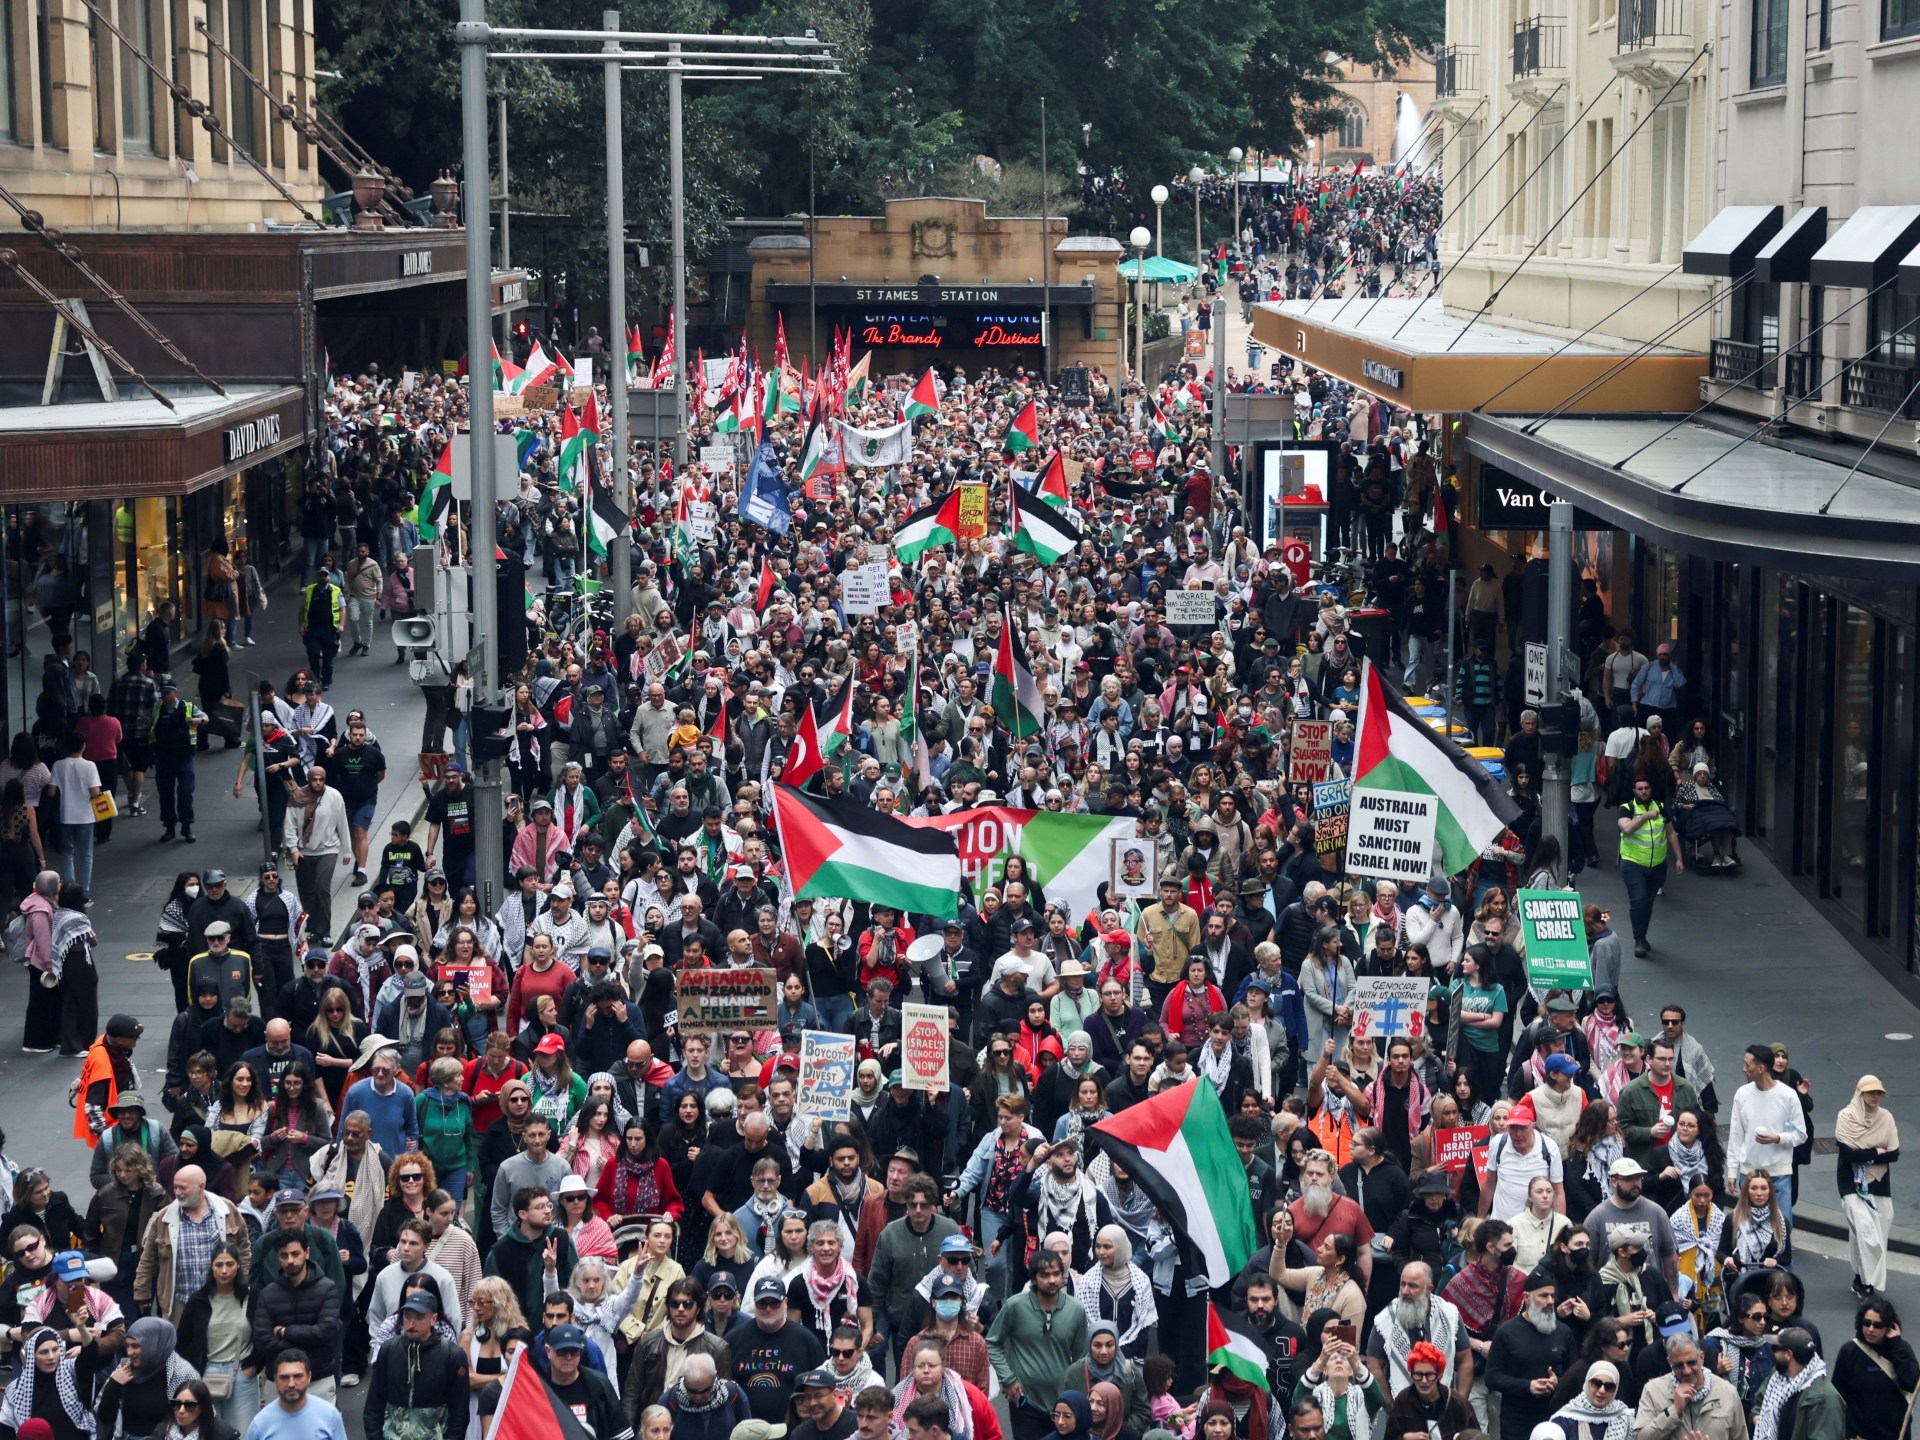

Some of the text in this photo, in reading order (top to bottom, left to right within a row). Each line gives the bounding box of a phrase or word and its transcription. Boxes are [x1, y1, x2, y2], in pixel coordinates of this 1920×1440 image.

[857, 291, 998, 300] ST JAMES STATION
[863, 325, 942, 348] The Brandy
[230, 414, 280, 460] DAVID JONES
[1496, 489, 1534, 506] Van
[1528, 650, 1543, 665] ONE
[1527, 667, 1545, 684] WAY
[1298, 724, 1328, 740] STOP
[1305, 740, 1320, 748] THE
[1292, 747, 1331, 762] SLAUGHTER
[1292, 763, 1328, 781] NOW
[1316, 803, 1348, 819] NO ON
[1360, 796, 1427, 816] AUSTRALIA
[1373, 817, 1410, 833] MUST
[1359, 835, 1421, 854] SANCTION
[389, 852, 411, 860] BATMAN
[1348, 852, 1428, 875] ISRAEL NOW!
[1525, 901, 1579, 919] SANCTION
[1536, 921, 1575, 939] ISRAEL
[1531, 958, 1545, 967] VOTE
[1567, 960, 1586, 969] GREENS
[681, 971, 763, 986] AOTEAROA
[1372, 981, 1418, 991] GENOCIDE
[681, 986, 771, 996] NEW ZEALAND
[1358, 991, 1377, 999] WITH
[700, 996, 761, 1006] DEMANDS
[683, 1006, 741, 1019] A FREE
[920, 1012, 944, 1020] PALESTINE
[681, 1020, 704, 1028] HANDS
[916, 1028, 937, 1037] STOP
[806, 1039, 848, 1061] BOYCOTT
[908, 1038, 945, 1050] ISRAEL'S
[908, 1050, 945, 1060] GENOCIDE
[803, 1062, 836, 1083] DIVEST
[915, 1061, 939, 1072] NOW!
[801, 1086, 848, 1108] SANCTION
[1453, 1132, 1472, 1142] END
